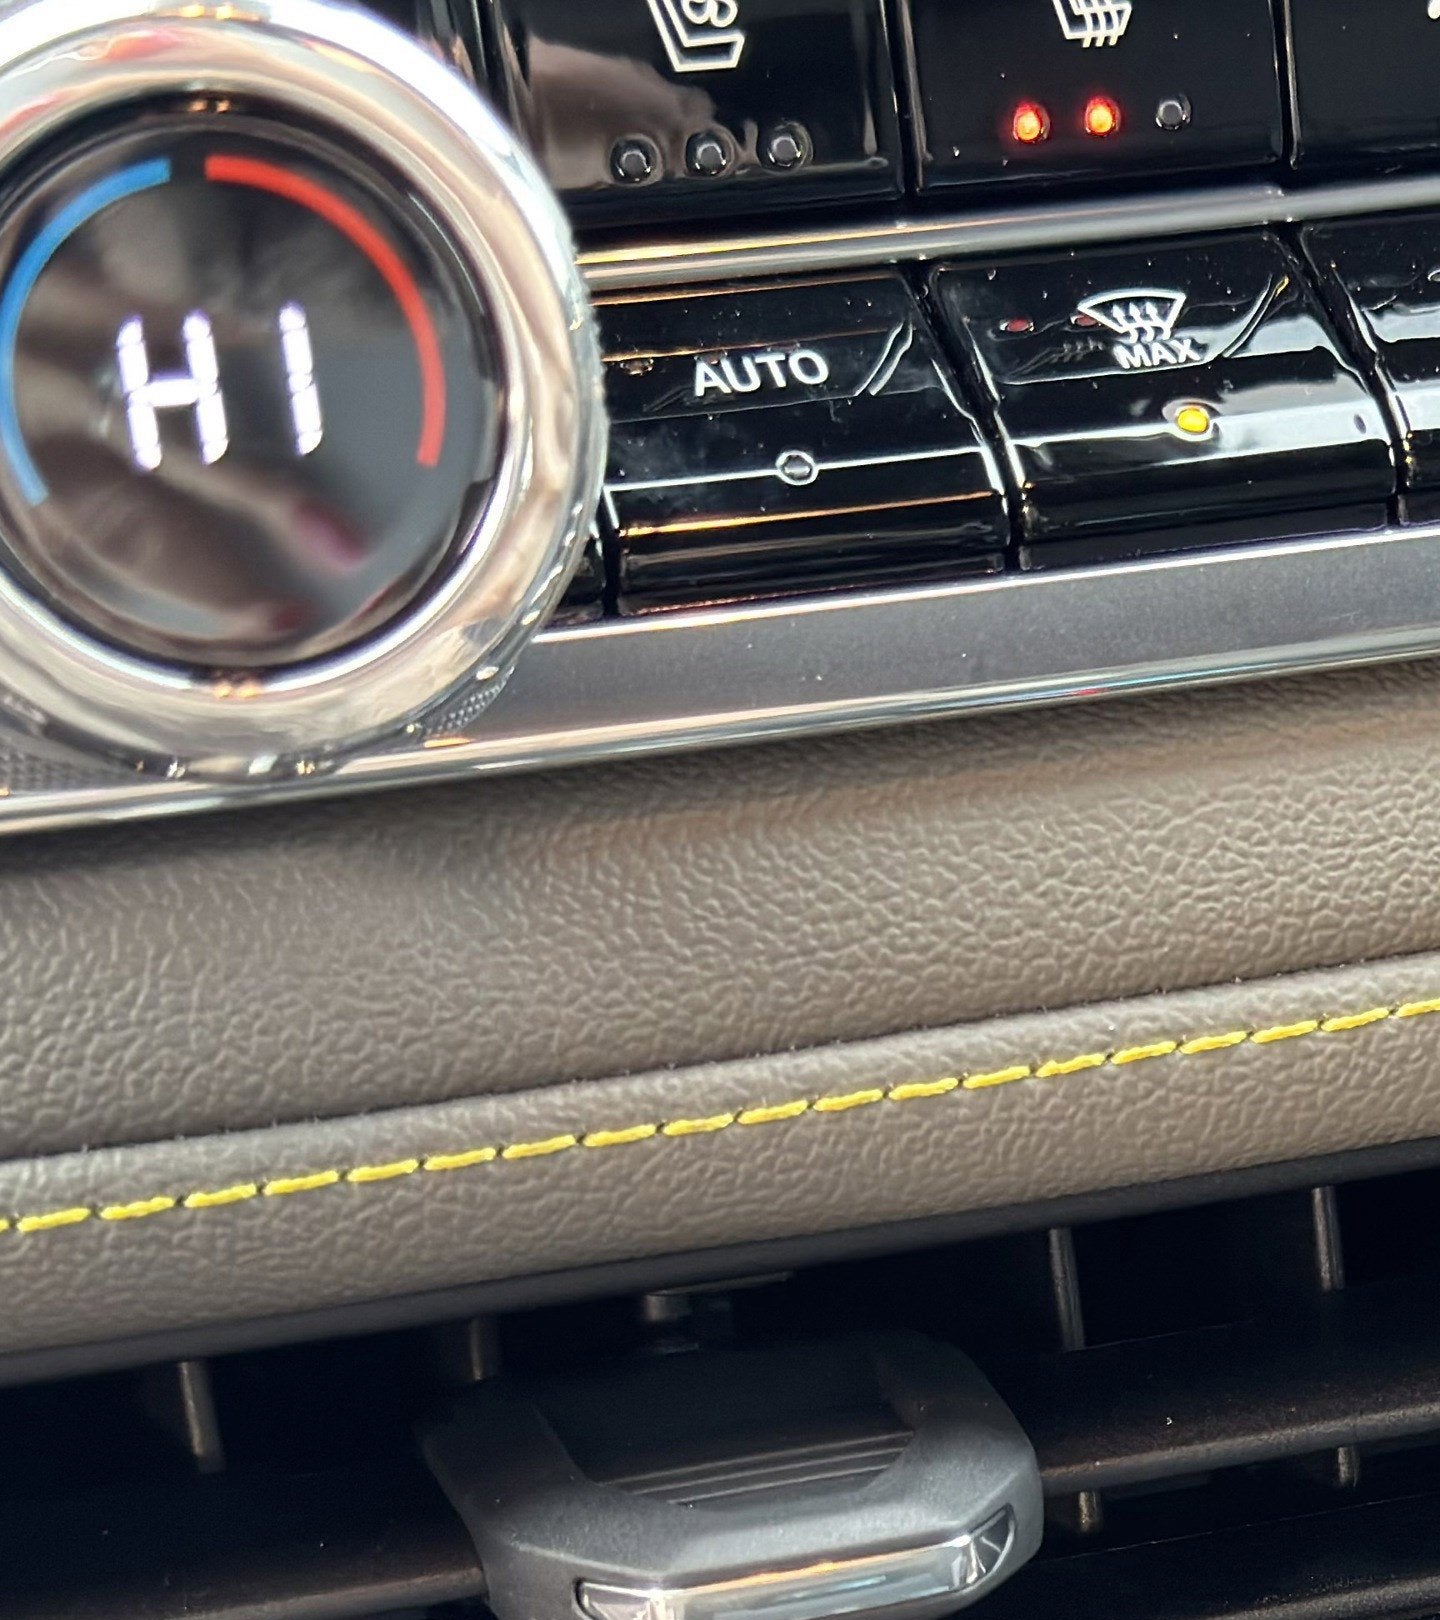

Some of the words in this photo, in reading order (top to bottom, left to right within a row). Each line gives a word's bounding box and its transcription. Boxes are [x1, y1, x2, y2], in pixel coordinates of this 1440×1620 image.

[694, 350, 829, 397] AUTO
[1113, 338, 1201, 369] MAX
[116, 302, 323, 472] HI
